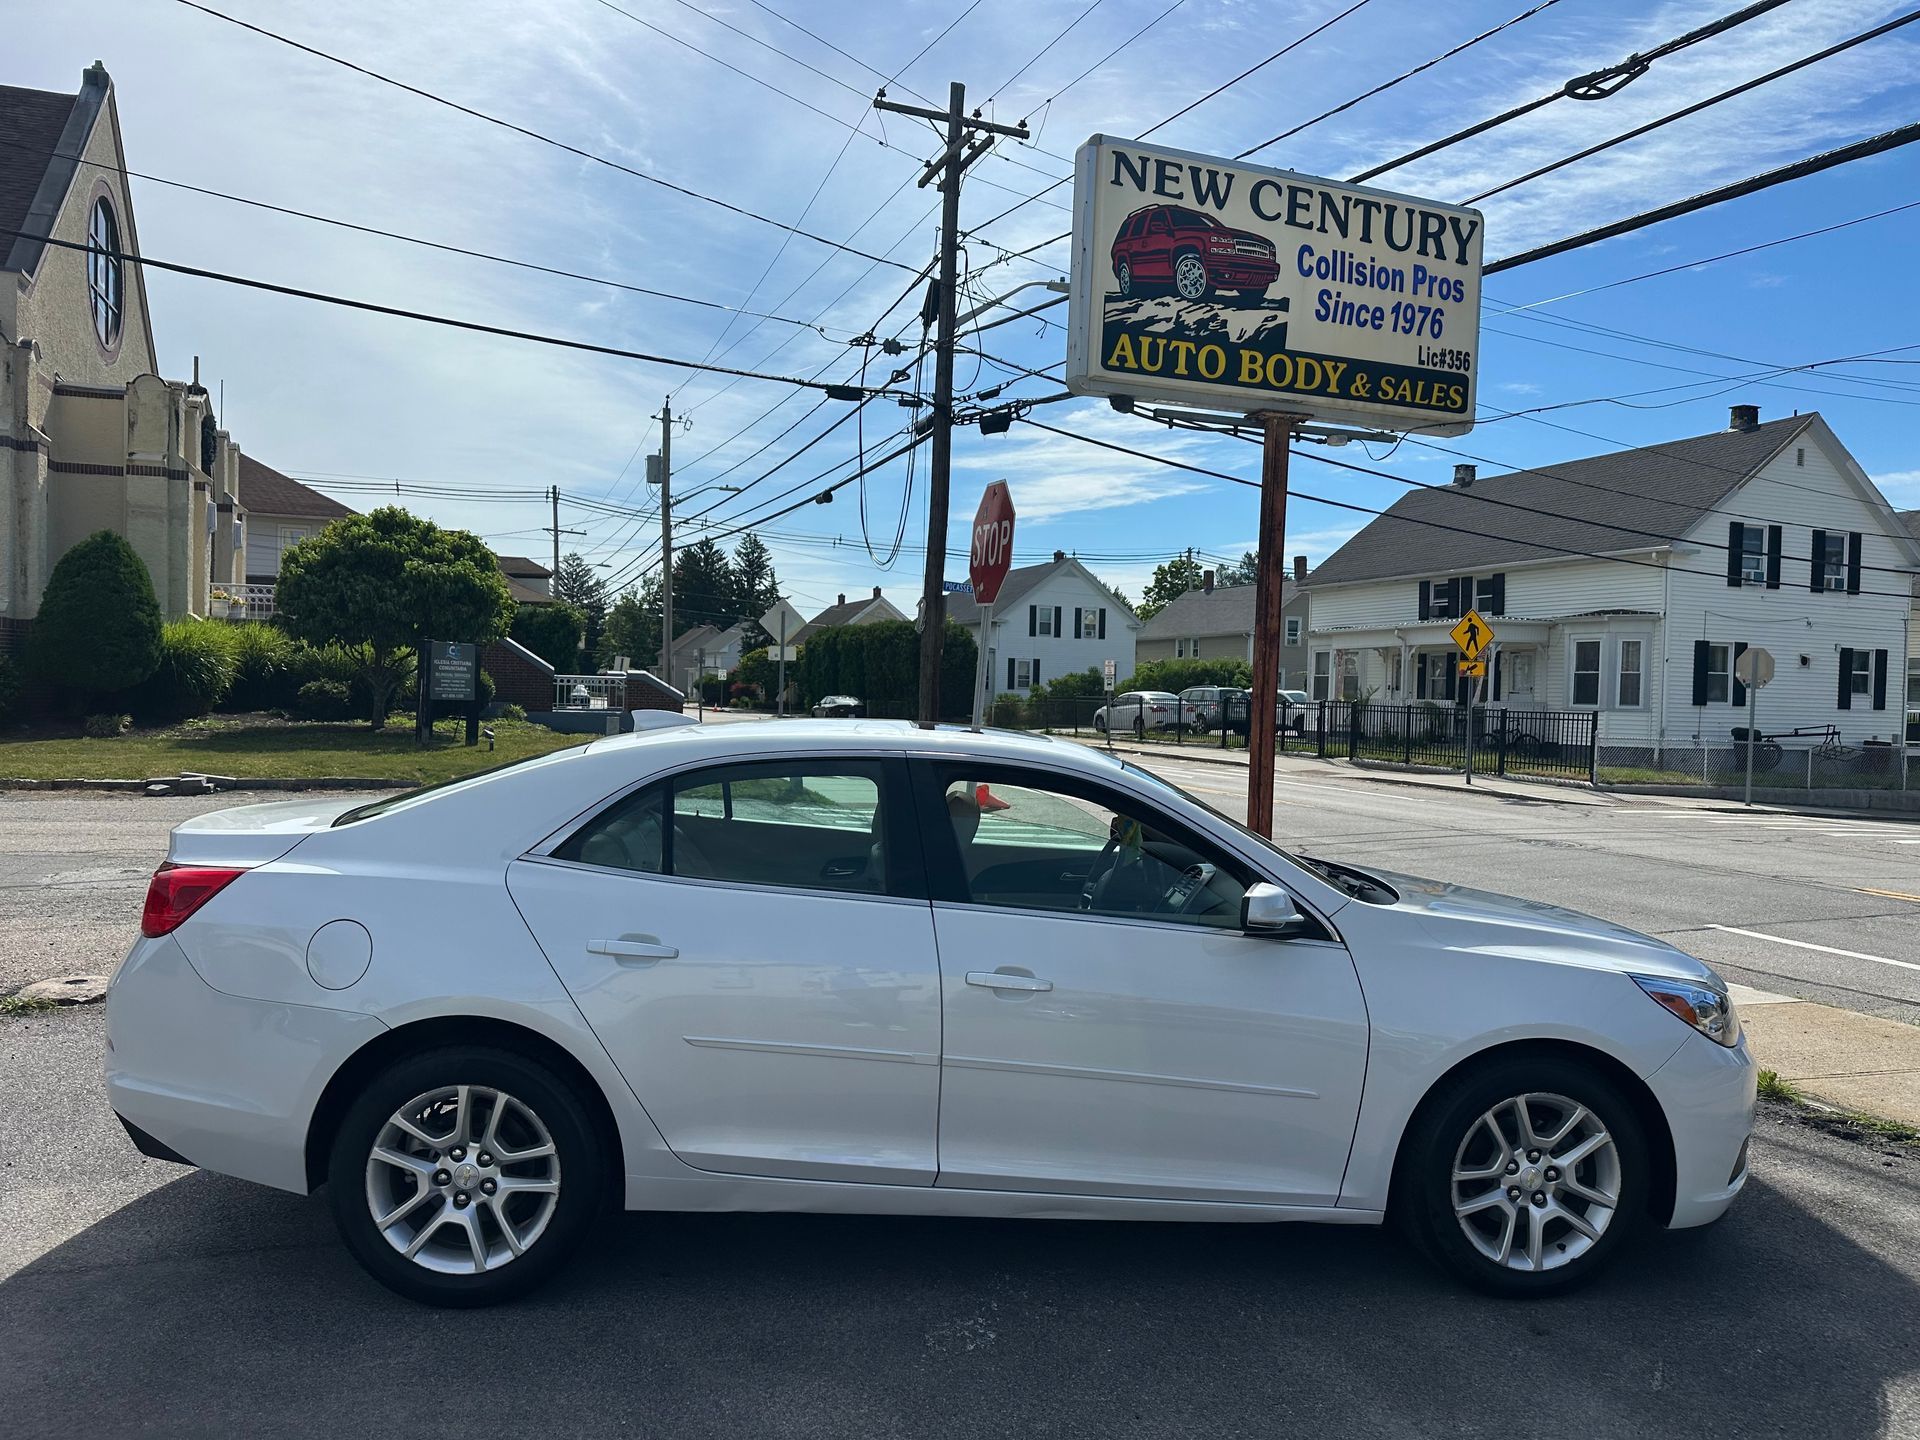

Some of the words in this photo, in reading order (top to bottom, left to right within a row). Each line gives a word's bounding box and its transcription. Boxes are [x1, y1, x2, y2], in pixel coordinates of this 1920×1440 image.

[1110, 150, 1235, 210] NEW
[1250, 179, 1478, 265] CENTURY
[1297, 244, 1404, 293] Collision
[1412, 263, 1464, 303] Pros
[1315, 288, 1385, 330] Since
[1390, 301, 1445, 339] 1976
[1107, 333, 1226, 379] AUTO
[1238, 349, 1347, 394] BODY
[1350, 372, 1372, 398] &
[1377, 376, 1464, 409] SALES
[1418, 345, 1470, 372] Lic#356
[973, 520, 1010, 567] STOP
